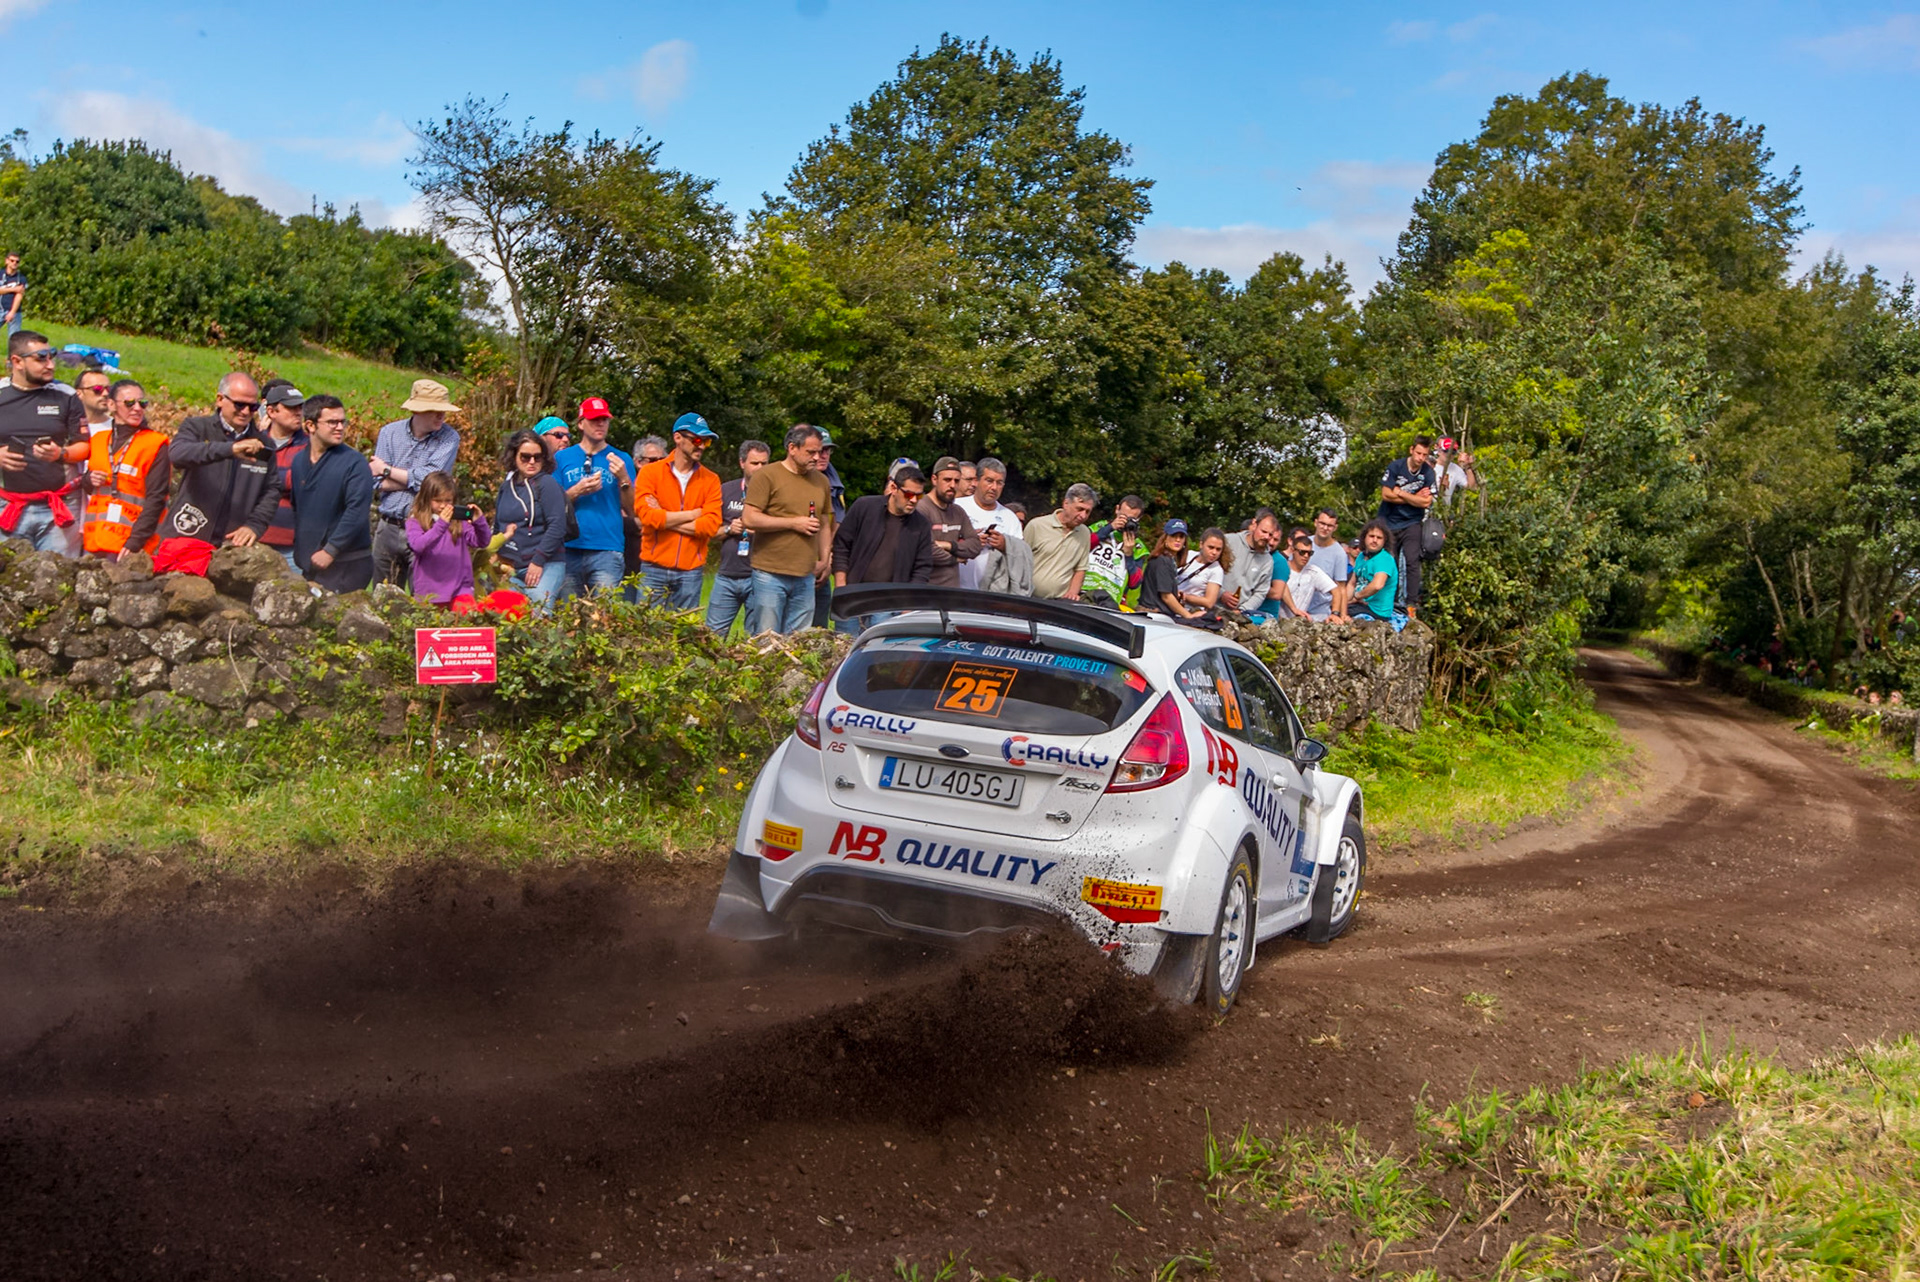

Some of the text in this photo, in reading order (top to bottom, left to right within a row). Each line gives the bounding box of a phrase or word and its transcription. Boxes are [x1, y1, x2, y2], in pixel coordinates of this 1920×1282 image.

[1094, 557, 1114, 570] MEDIA
[982, 645, 1007, 658] GOT
[1006, 648, 1054, 665] TALENT?
[1054, 655, 1090, 672] PROVE
[1090, 662, 1108, 675] IT!
[944, 676, 1001, 712] 25
[1216, 678, 1243, 730] 25
[827, 741, 848, 753] RS
[897, 763, 935, 789] LU
[941, 770, 1017, 801] 405GJ
[1243, 767, 1295, 856] QUALITY
[896, 838, 1058, 885] QUALITY
